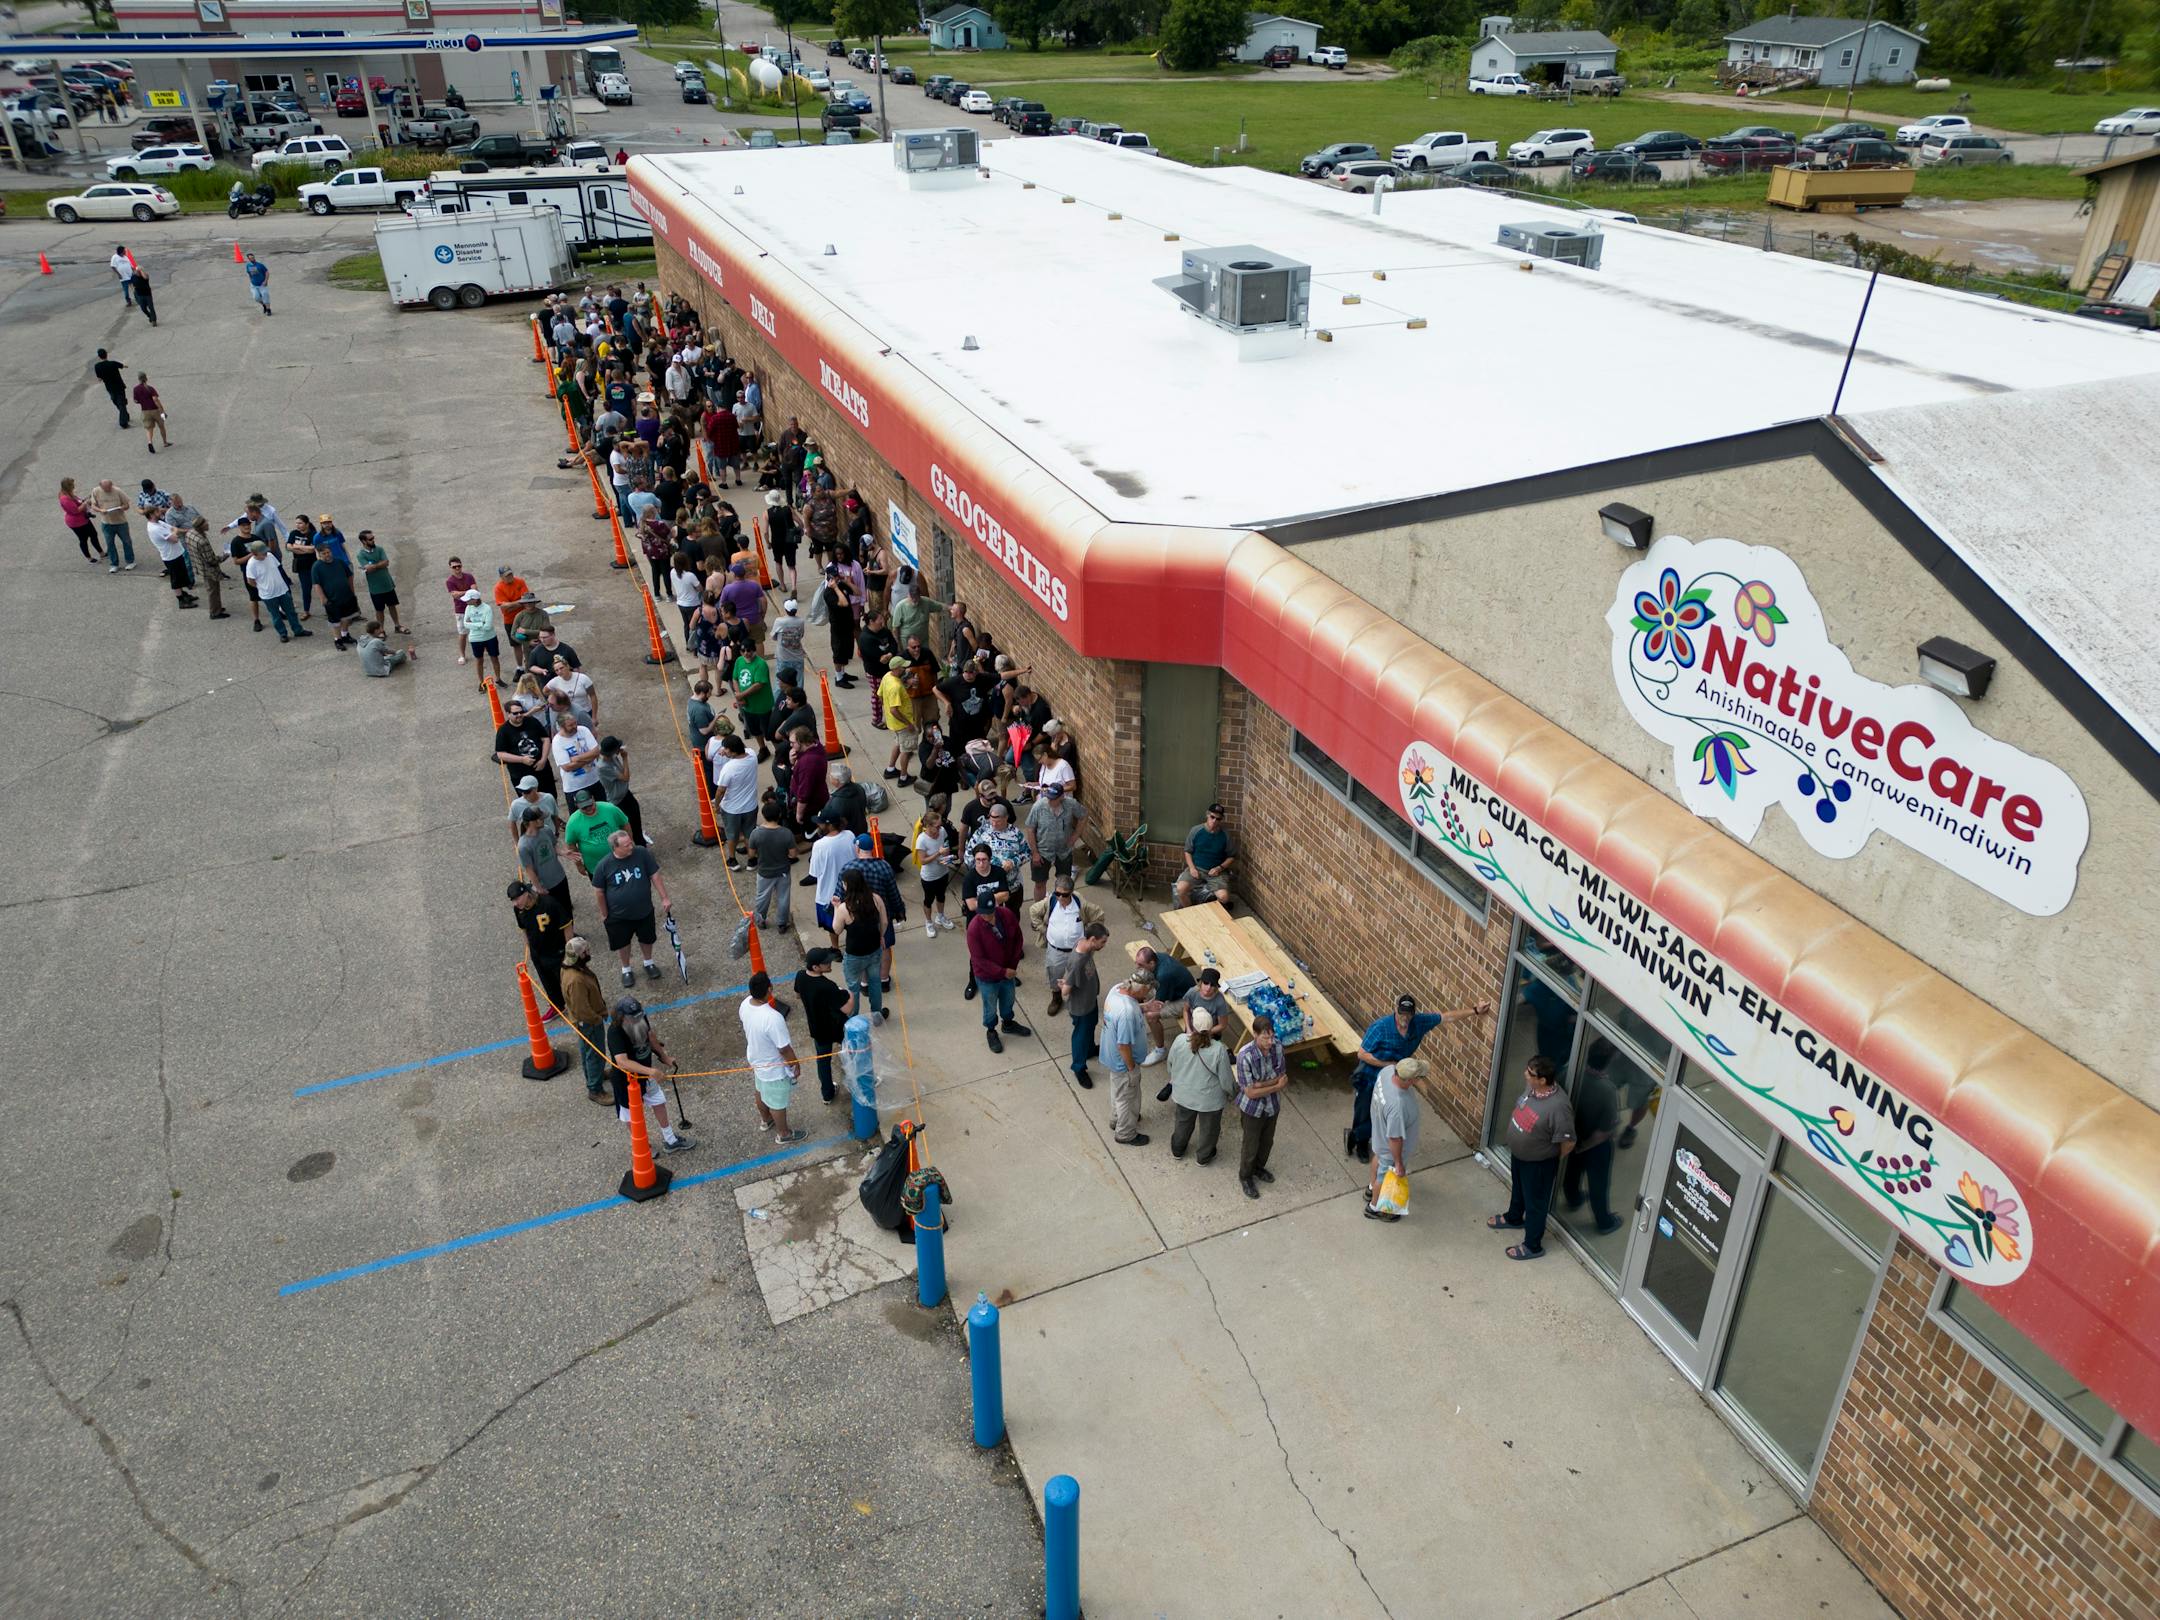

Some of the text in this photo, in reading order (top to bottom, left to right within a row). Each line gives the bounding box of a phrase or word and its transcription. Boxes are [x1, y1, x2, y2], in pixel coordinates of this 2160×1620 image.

[426, 39, 459, 49] ARCO
[454, 241, 488, 249] Mennonite
[687, 236, 723, 288] PRODUCE
[749, 293, 777, 338] DELI
[819, 358, 870, 428] MEATS
[930, 463, 1068, 621] GROCERIES
[1701, 624, 2043, 842] NativeCare
[1695, 678, 2032, 875] Anishinaabe Ganawenindiwin
[1449, 766, 1934, 1151] MIS-GUA-GA-MI-WI-SAGA-EH-GANING
[1577, 894, 1711, 1017] WIISINIWIN
[1688, 1160, 1732, 1202] NativeCare
[1665, 1199, 1674, 1209] No
[1692, 1224, 1700, 1235] No
